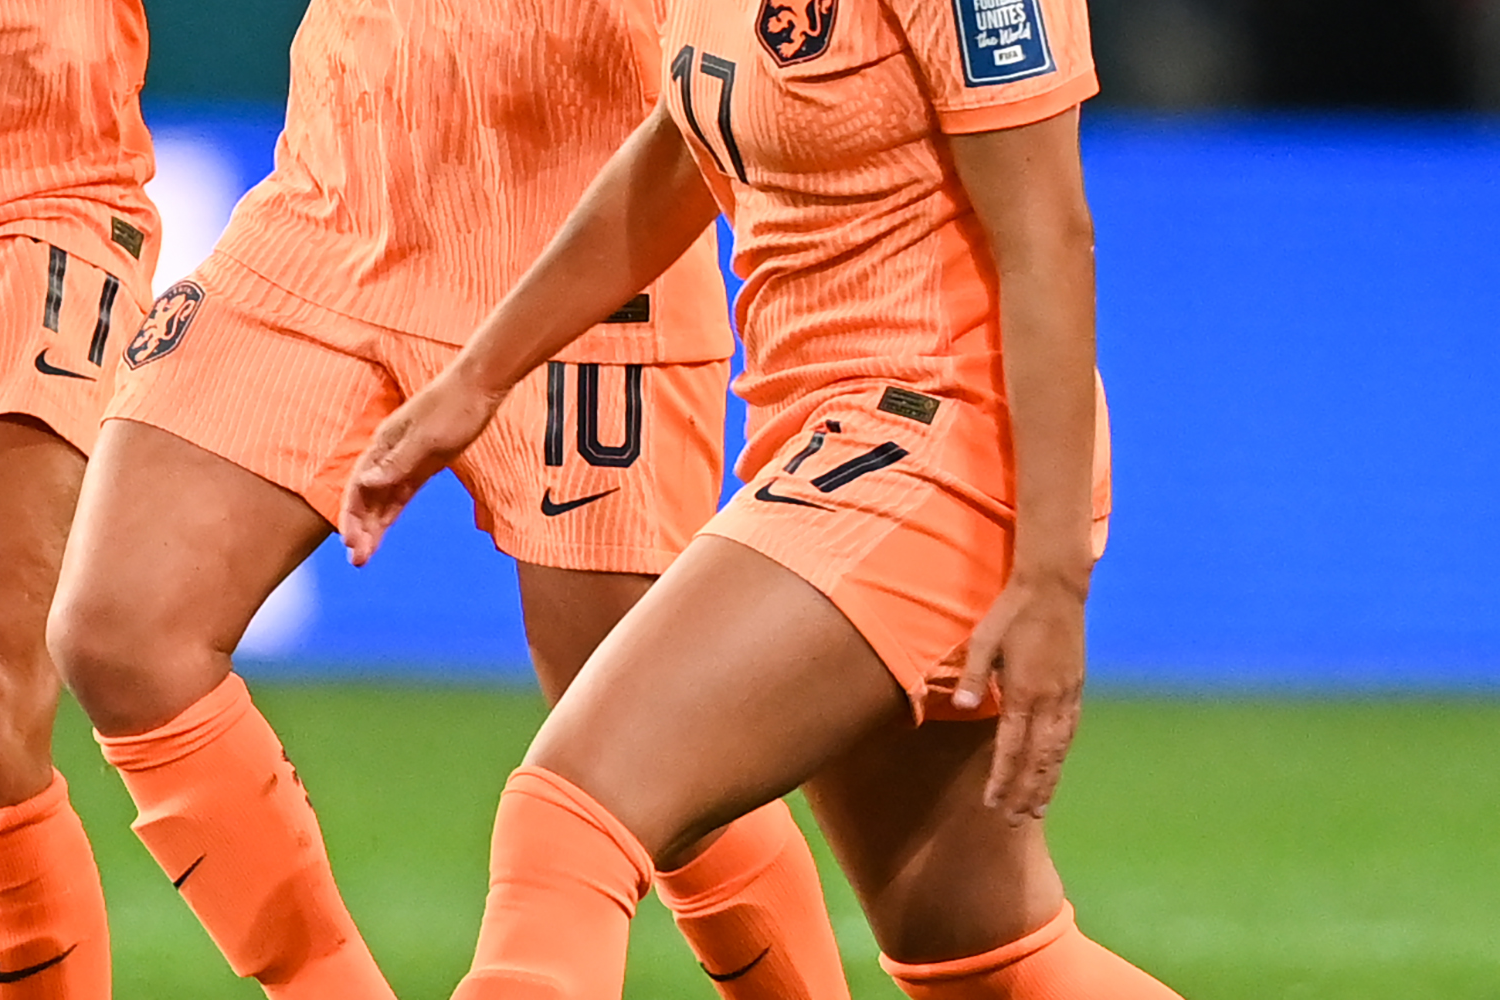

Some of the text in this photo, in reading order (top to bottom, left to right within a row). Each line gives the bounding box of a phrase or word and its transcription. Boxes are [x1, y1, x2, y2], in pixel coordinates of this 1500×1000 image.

[976, 2, 1026, 30] UNITES
[975, 21, 1031, 48] the World
[998, 50, 1019, 61] FIFA
[670, 44, 749, 185] 17
[544, 361, 642, 468] 10
